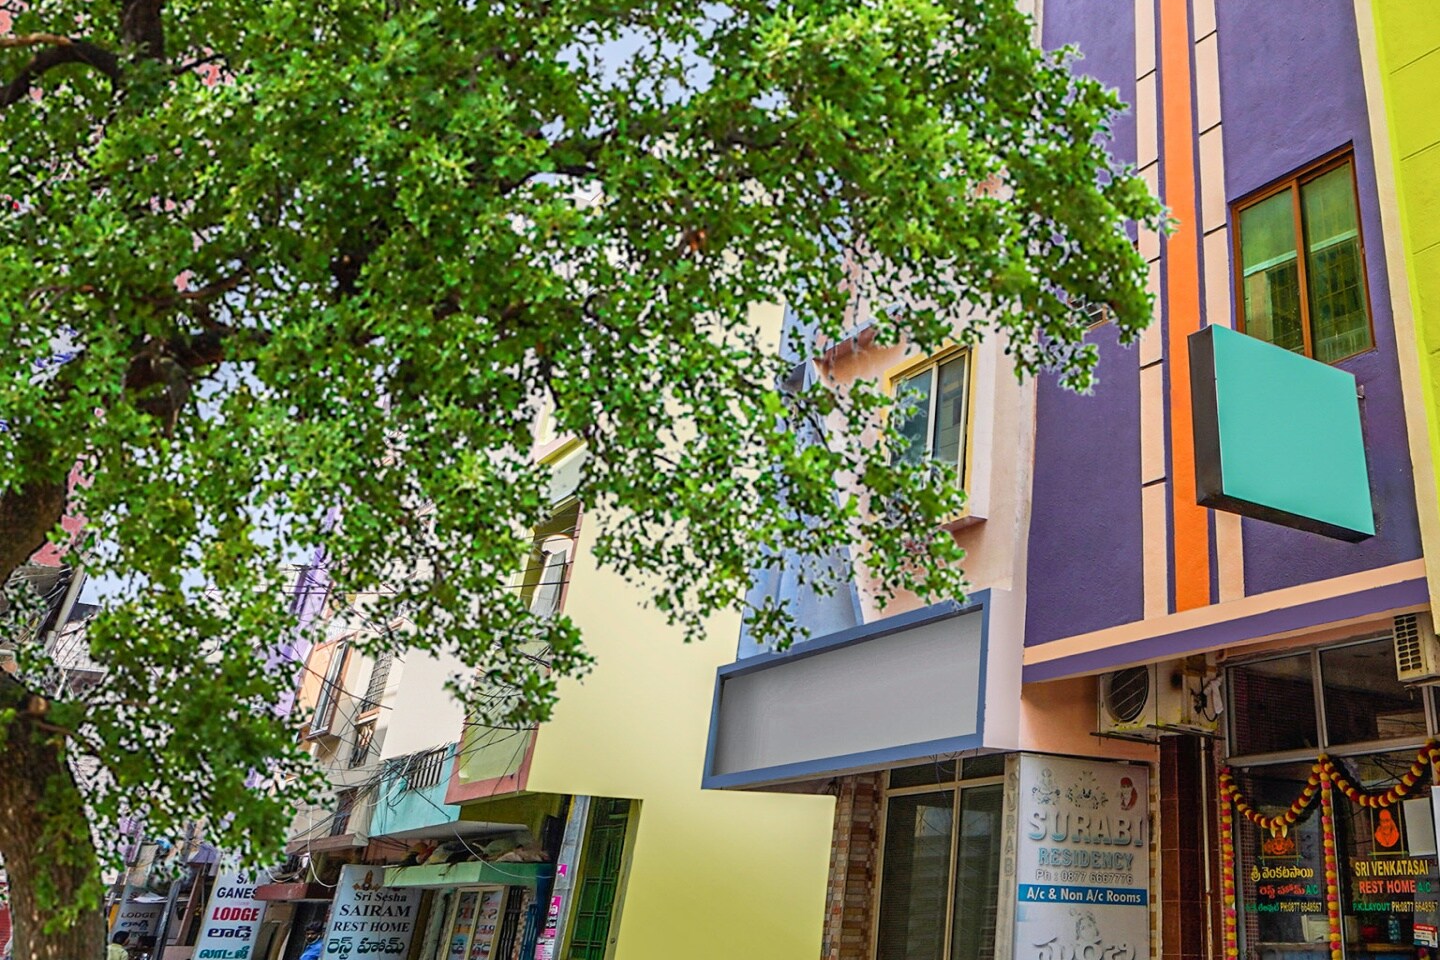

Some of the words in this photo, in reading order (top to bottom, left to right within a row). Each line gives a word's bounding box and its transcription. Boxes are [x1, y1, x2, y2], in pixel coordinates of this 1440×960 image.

[1027, 810, 1144, 848] SURABI
[1038, 847, 1134, 871] RESIDENCY
[1355, 861, 1370, 876] SRI
[1371, 859, 1429, 876] VENKATASAI
[1035, 868, 1052, 880] Ph
[1061, 869, 1087, 881] 0877
[1359, 880, 1384, 893] REST
[1386, 880, 1416, 893] HOME
[354, 892, 372, 901] Sri
[374, 892, 407, 902] Sesha
[1027, 886, 1045, 900] A/c
[1048, 887, 1057, 900] &
[1061, 888, 1083, 901] Non
[1086, 889, 1104, 901] A/c
[1107, 889, 1141, 903] Rooms
[211, 907, 260, 921] LODGE
[339, 904, 412, 917] SAIRAM
[333, 921, 369, 932] REST
[370, 922, 410, 932] HOME
